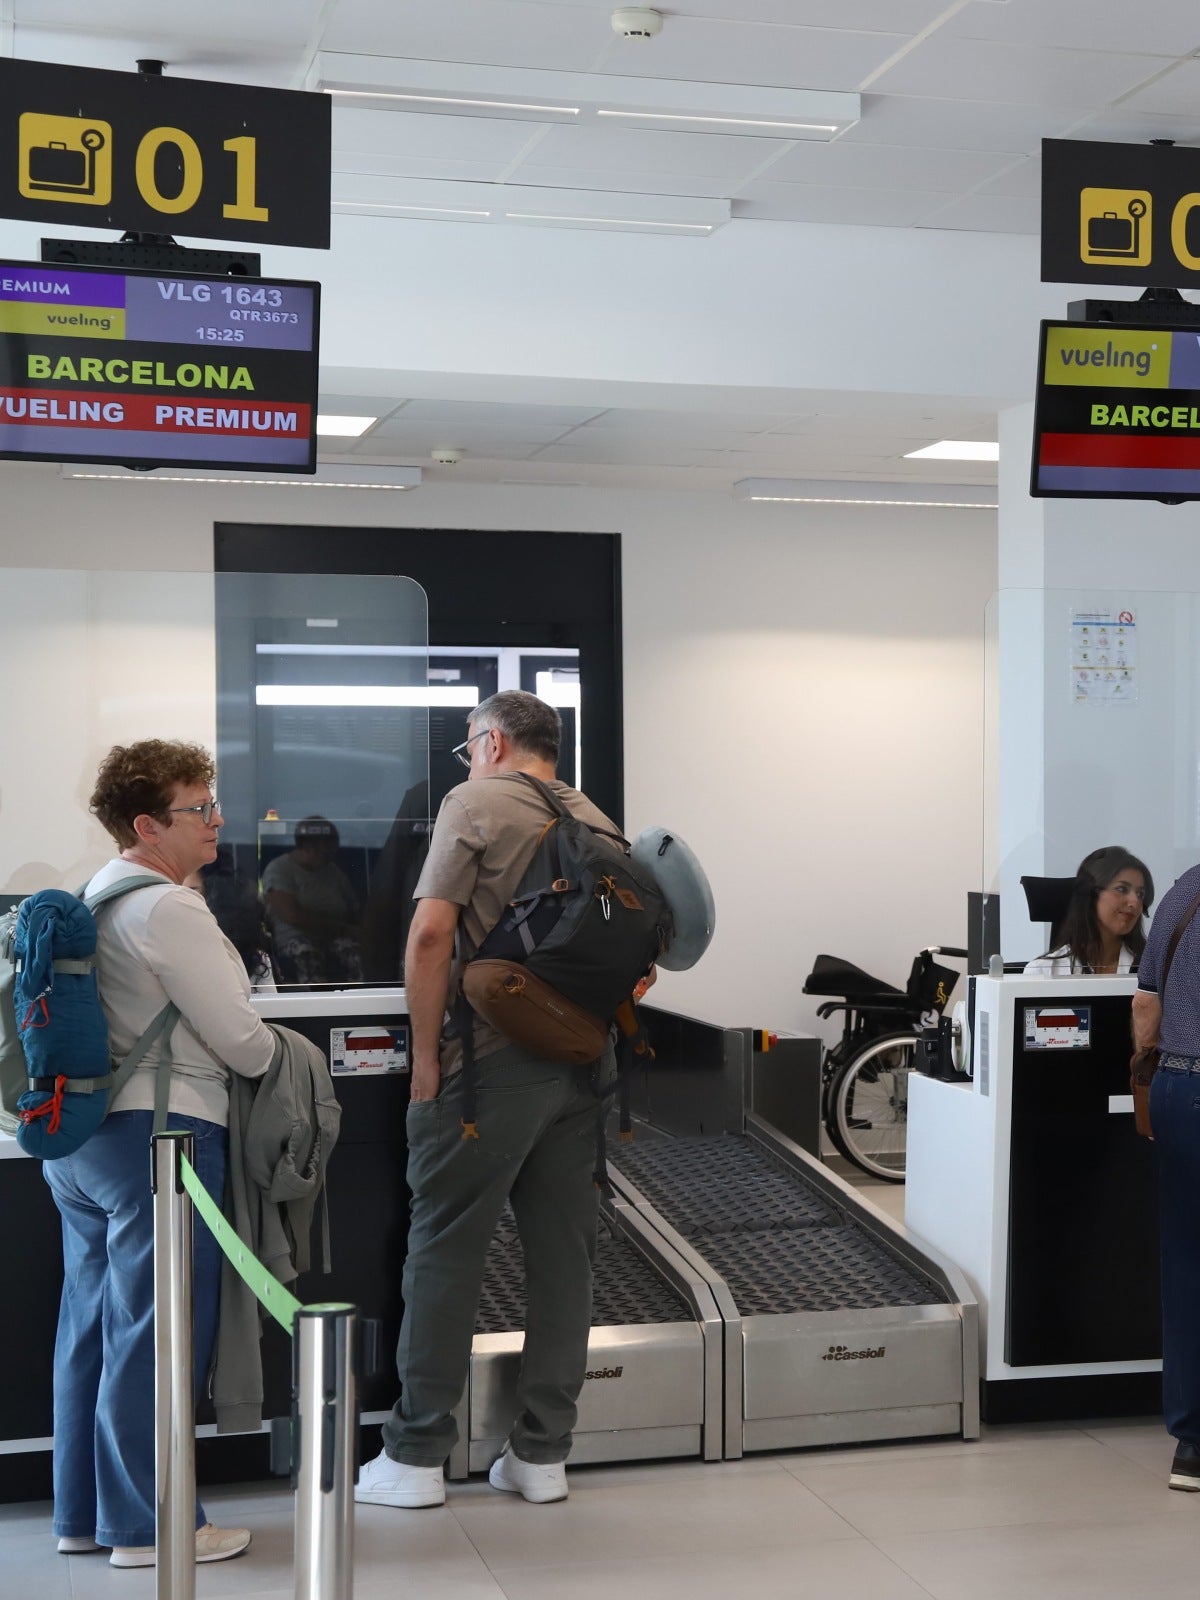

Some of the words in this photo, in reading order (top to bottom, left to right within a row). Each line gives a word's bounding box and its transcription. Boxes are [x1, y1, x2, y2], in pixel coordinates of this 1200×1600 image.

[135, 126, 269, 222] 01
[0, 278, 70, 295] EMIUM
[157, 281, 212, 303] VLG
[221, 286, 283, 307] 1643
[47, 313, 112, 330] vueling
[229, 309, 299, 325] QTR3673
[196, 327, 245, 342] 15:25
[1060, 341, 1151, 376] vueling
[27, 354, 255, 391] BARCELONA
[0, 397, 125, 423] UELING
[155, 405, 297, 432] PREMIUM
[834, 1346, 886, 1361] cassioli
[585, 1366, 624, 1380] ssioli
